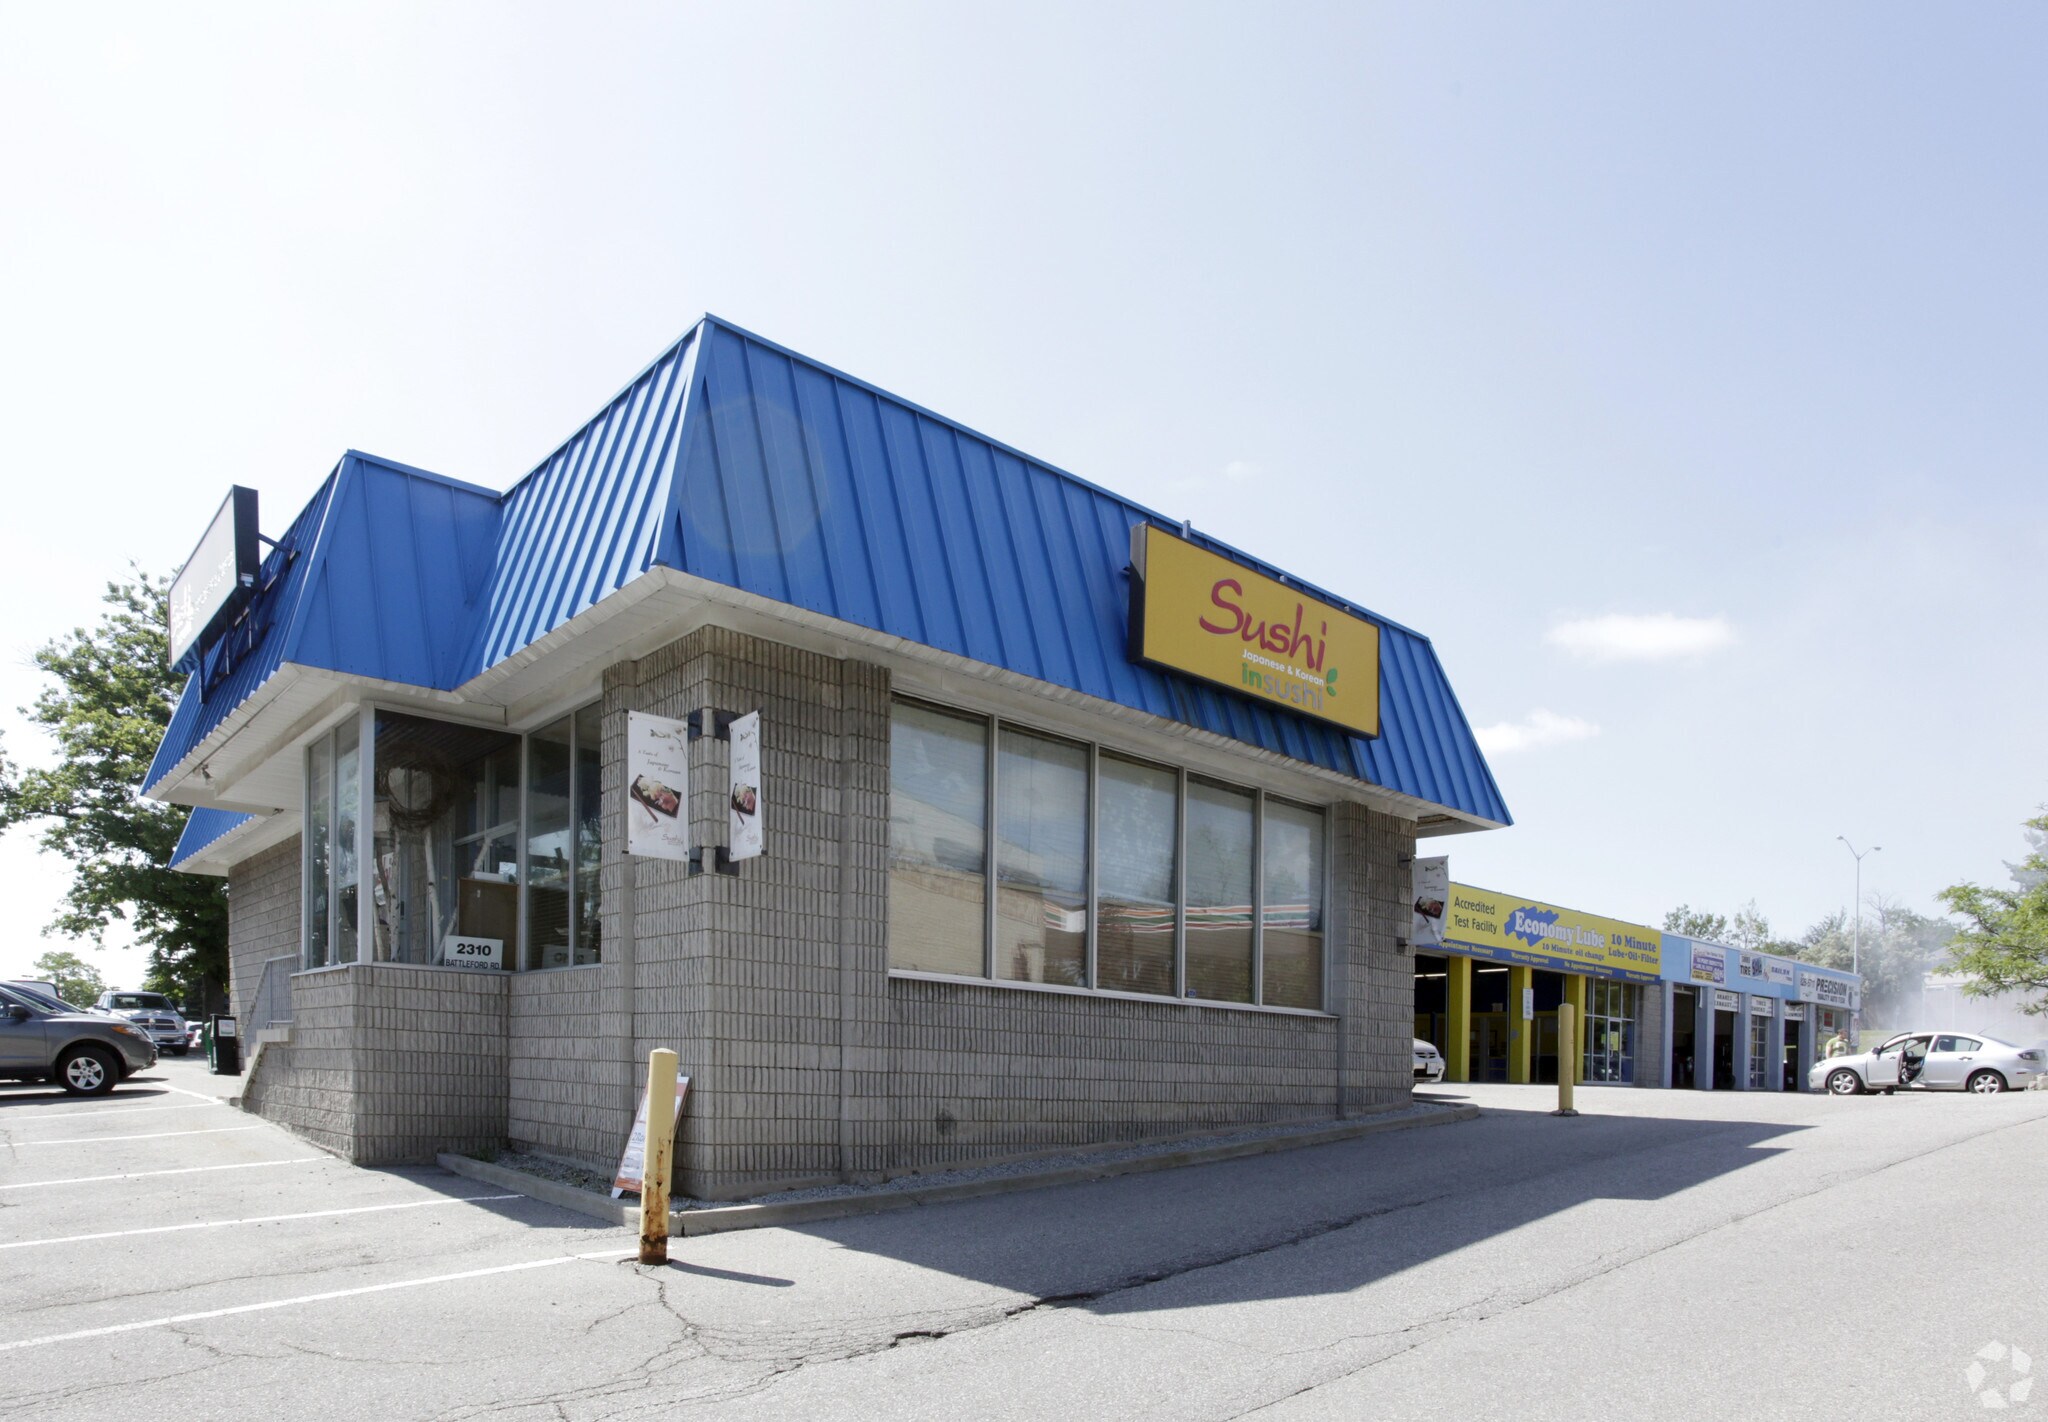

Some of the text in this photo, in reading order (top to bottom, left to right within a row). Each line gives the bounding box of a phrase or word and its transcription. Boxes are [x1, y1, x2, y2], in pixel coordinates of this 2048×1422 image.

[1199, 579, 1327, 672] Sushi
[1242, 649, 1324, 687] Japanese & Korean
[1242, 662, 1324, 711] insushi
[1454, 896, 1495, 915] Accredited
[1454, 914, 1498, 935] Test Facility
[1514, 910, 1605, 949] Economy Lube
[456, 943, 492, 957] 2310
[1542, 943, 1605, 962] 10 Minute oil change
[1611, 933, 1657, 953] 10 Minute
[445, 958, 489, 970] BATTLEFORD
[1815, 977, 1848, 997] PRECISION
